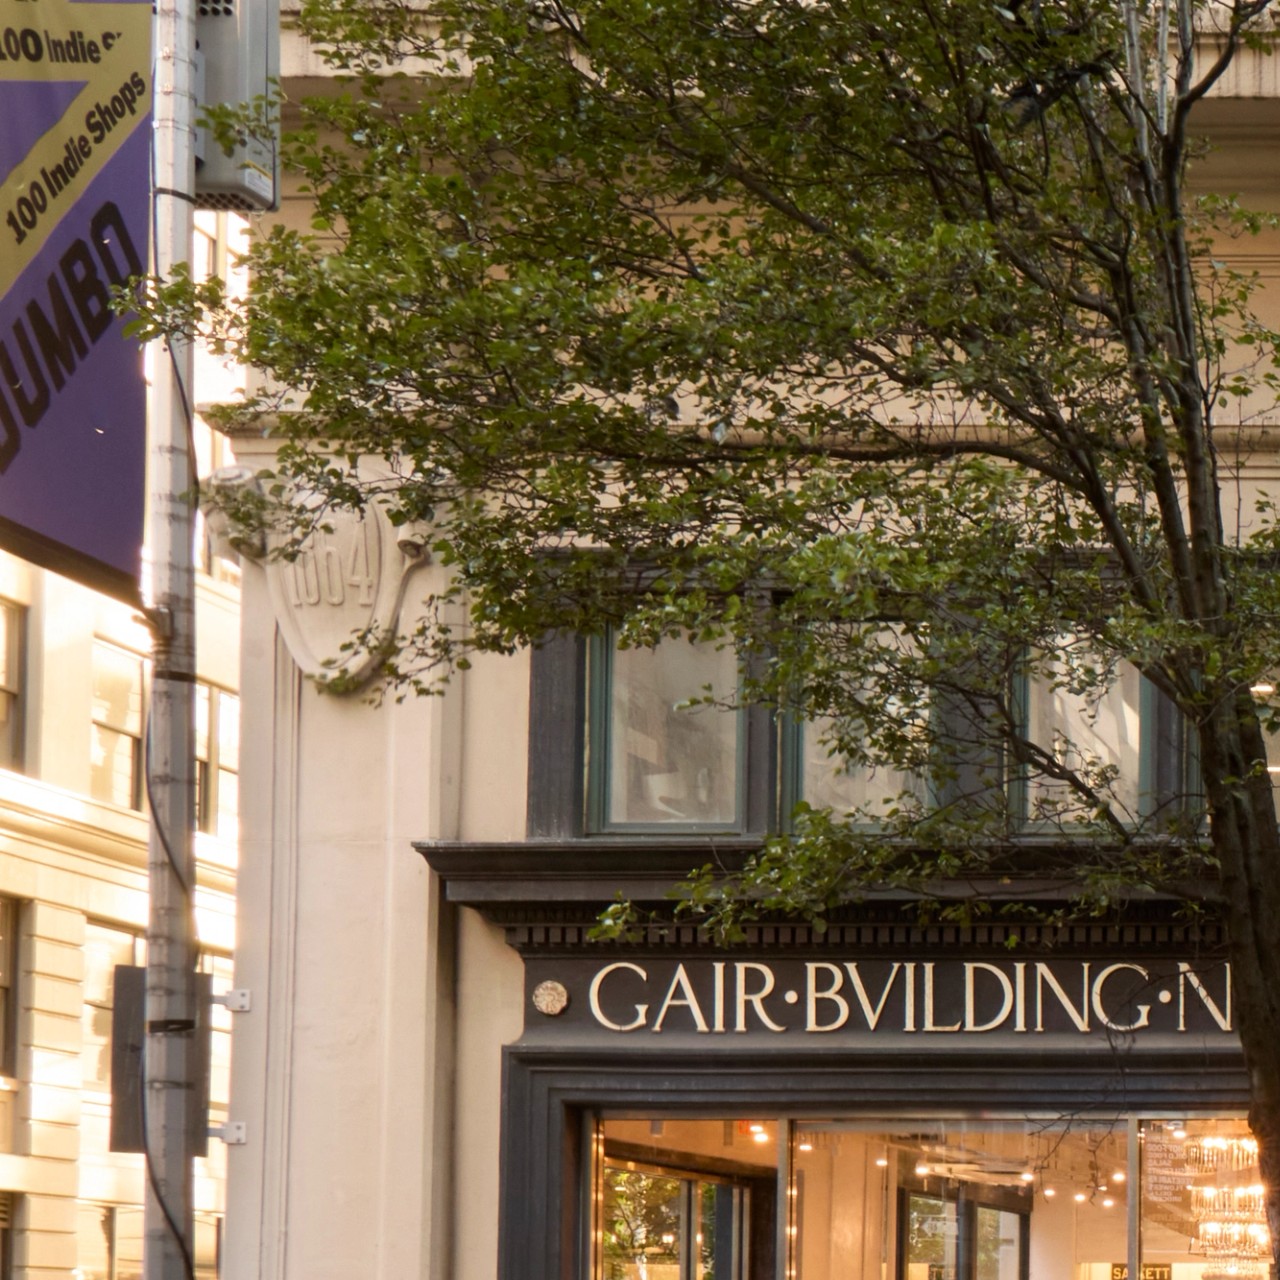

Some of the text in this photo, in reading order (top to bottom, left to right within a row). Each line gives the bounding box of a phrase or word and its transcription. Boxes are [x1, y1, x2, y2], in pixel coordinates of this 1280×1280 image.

[0, 27, 43, 62] 00
[44, 29, 102, 64] Indie
[6, 180, 48, 245] 100
[40, 134, 92, 199] Indie
[85, 71, 146, 144] Shops
[589, 962, 788, 1032] GAIR
[1113, 1267, 1170, 1280] SAETT
